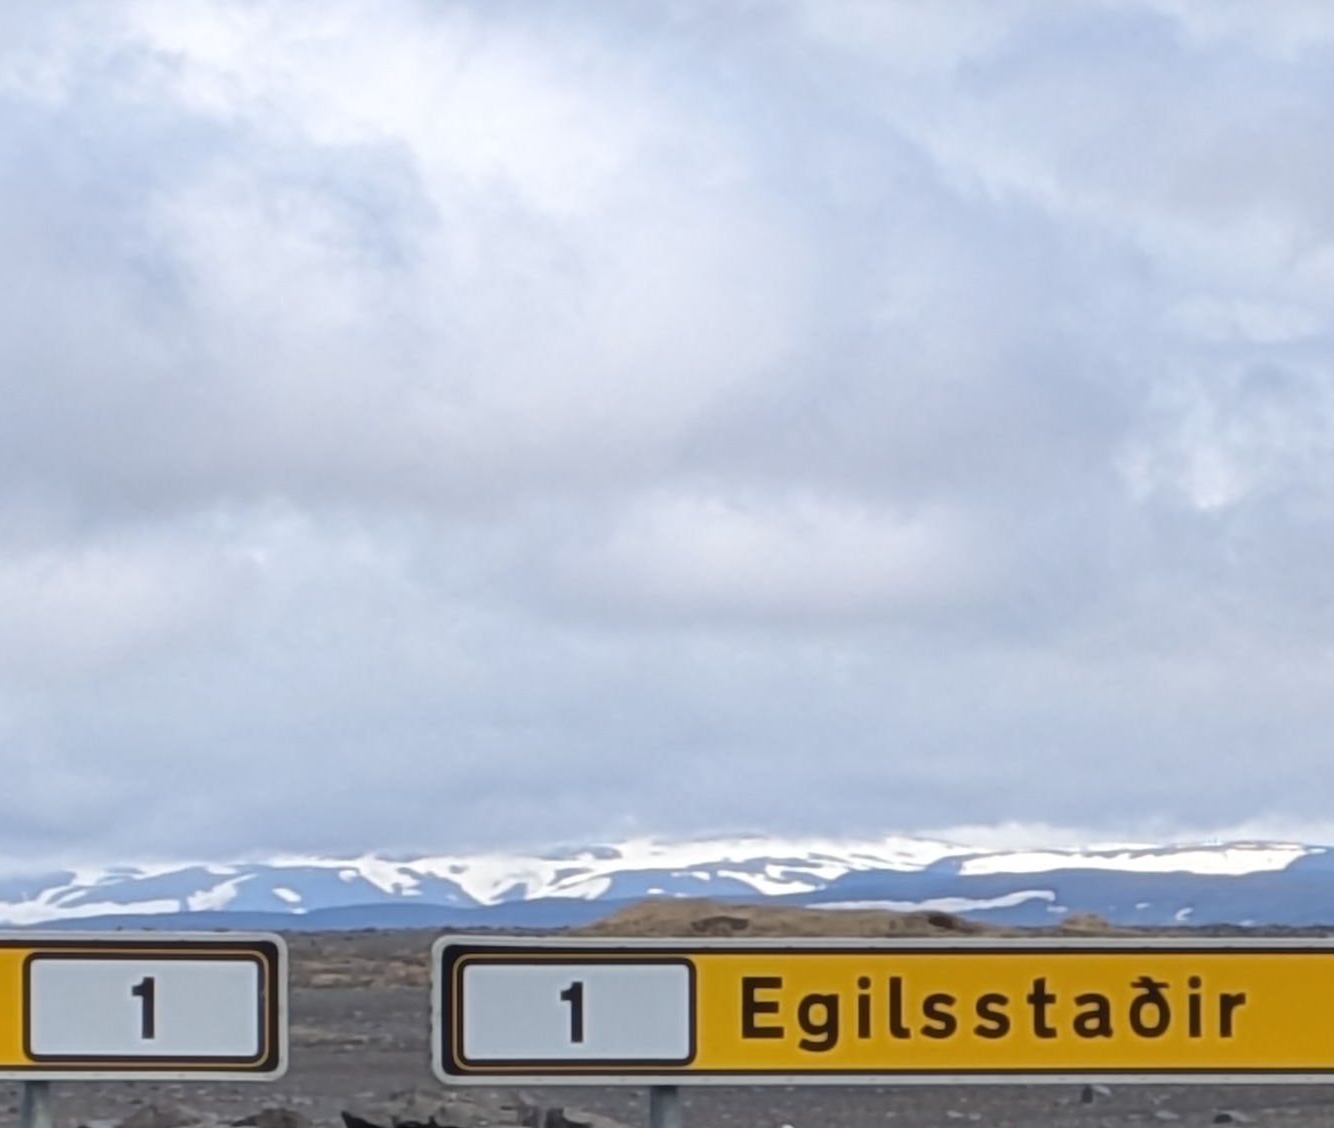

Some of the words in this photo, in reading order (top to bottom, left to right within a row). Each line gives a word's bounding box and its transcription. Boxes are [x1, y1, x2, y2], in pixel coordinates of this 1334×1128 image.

[131, 976, 155, 1040] 1
[560, 981, 584, 1043] 1
[741, 976, 1247, 1053] Egilsstaðir
